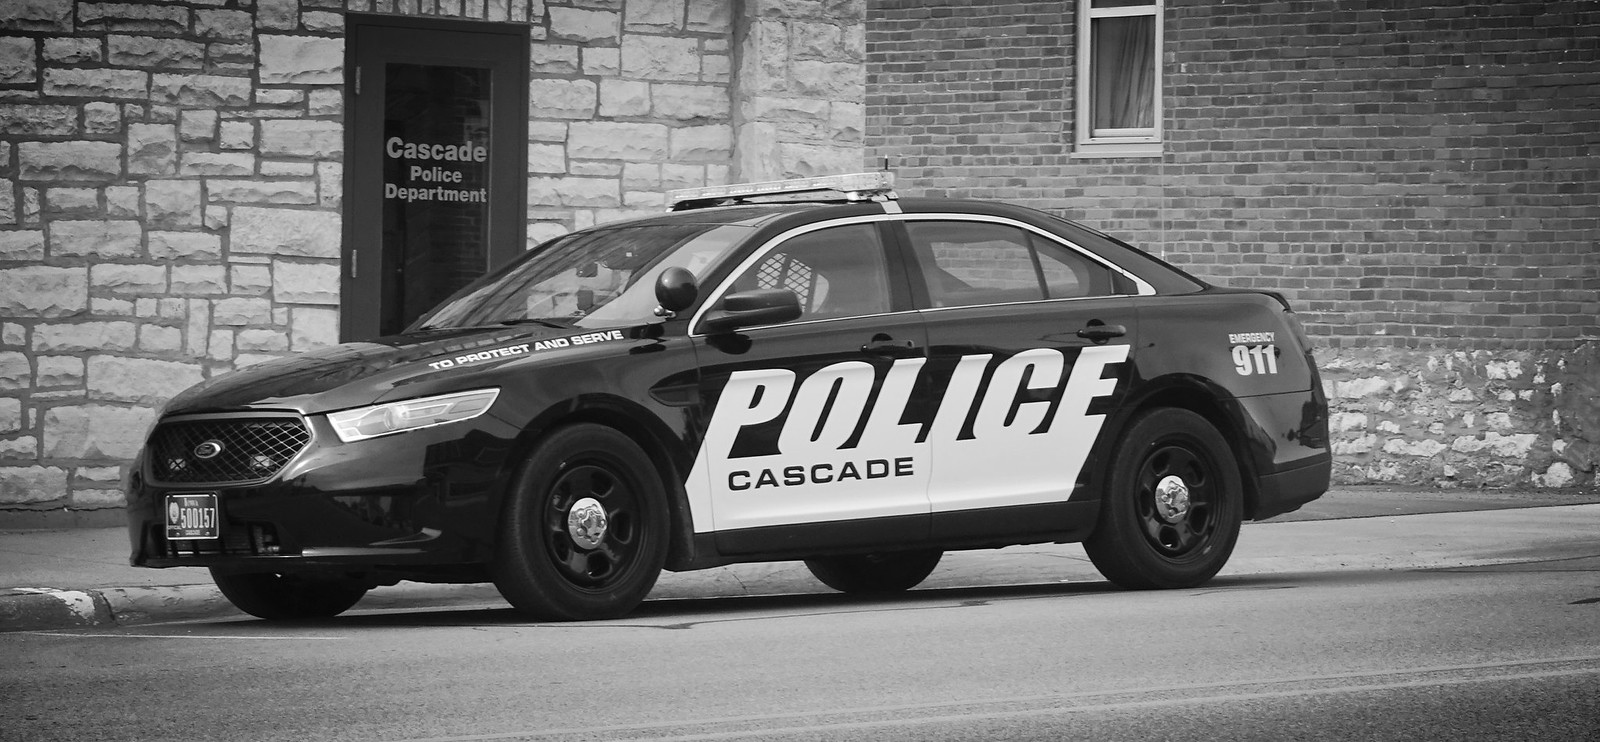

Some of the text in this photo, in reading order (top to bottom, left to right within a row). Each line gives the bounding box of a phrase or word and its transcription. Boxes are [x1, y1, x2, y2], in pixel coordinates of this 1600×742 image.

[386, 136, 487, 162] Cascade
[410, 165, 463, 183] Police
[384, 182, 487, 203] Department
[428, 329, 624, 370] TO PROTECT AND SERVE
[1228, 331, 1275, 344] EMERGENCY
[1231, 344, 1278, 376] 911
[705, 344, 1131, 458] POLICE
[728, 456, 915, 491] CASCADE
[180, 507, 215, 529] 500157
